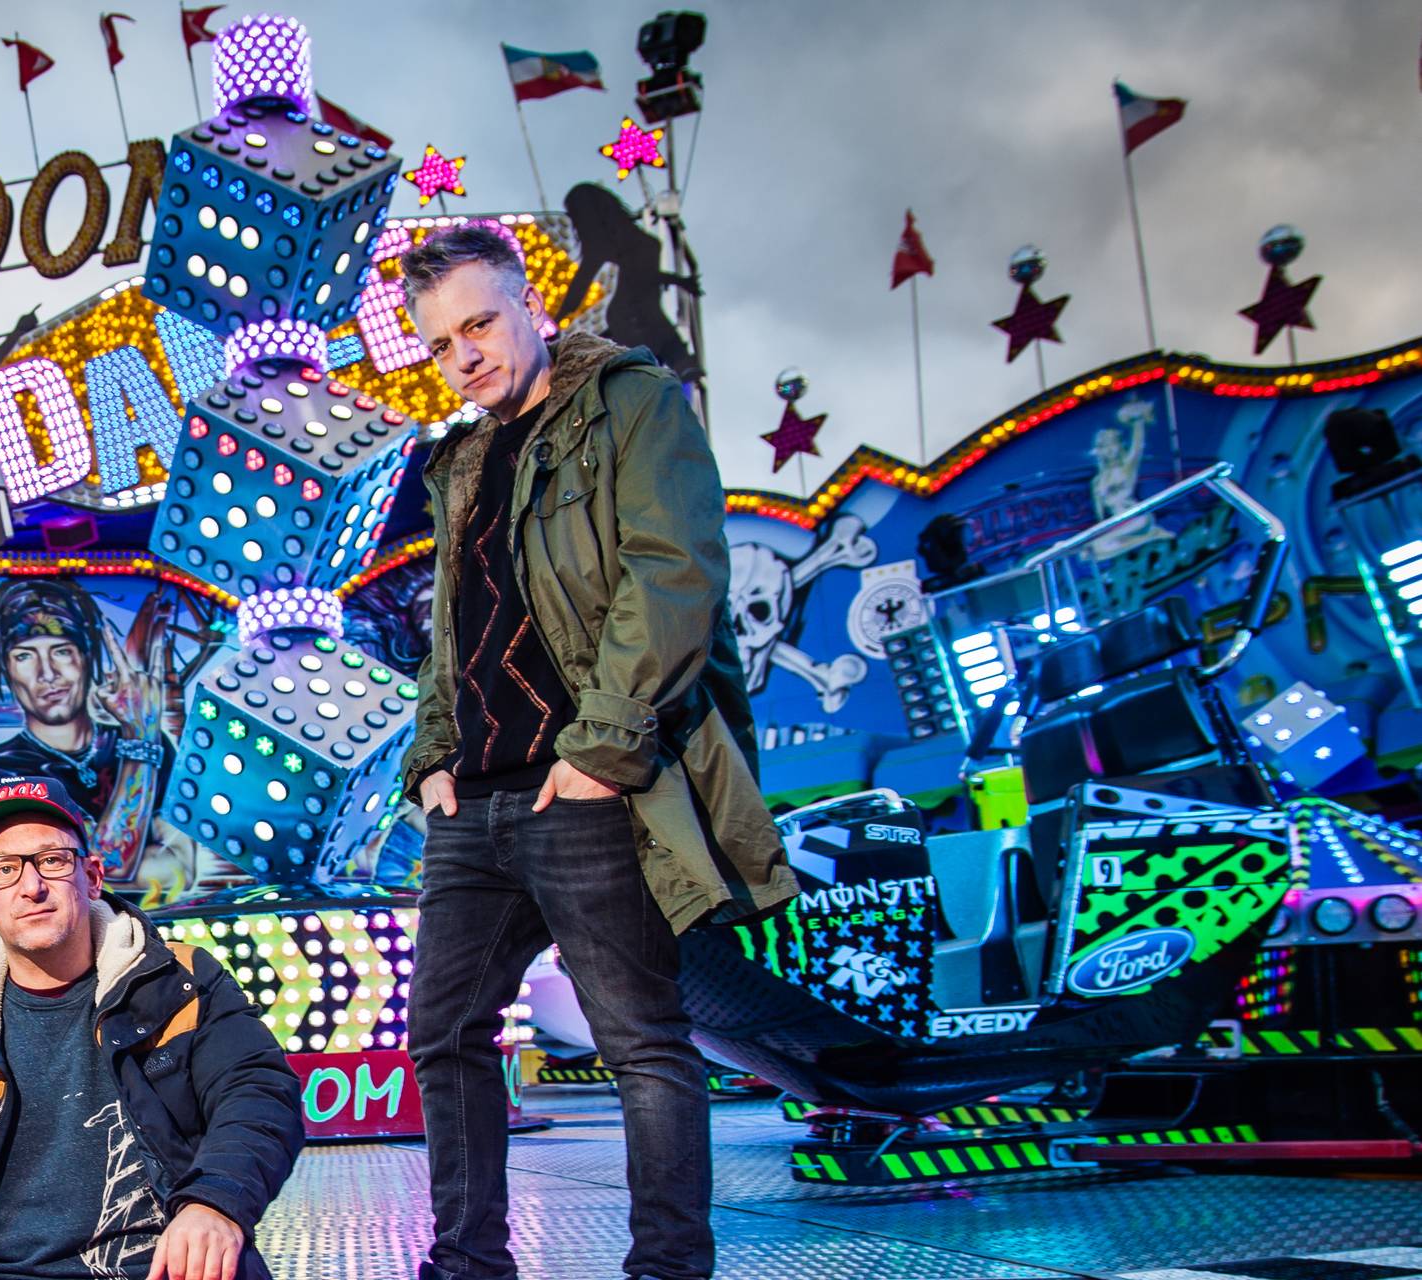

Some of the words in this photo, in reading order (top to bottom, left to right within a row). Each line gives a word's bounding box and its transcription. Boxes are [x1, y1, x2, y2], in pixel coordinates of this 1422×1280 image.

[864, 823, 921, 845] STR
[1099, 859, 1114, 883] 9
[808, 907, 926, 930] ENERGY
[1094, 940, 1172, 988] Ford
[929, 1011, 1038, 1038] EXEDY
